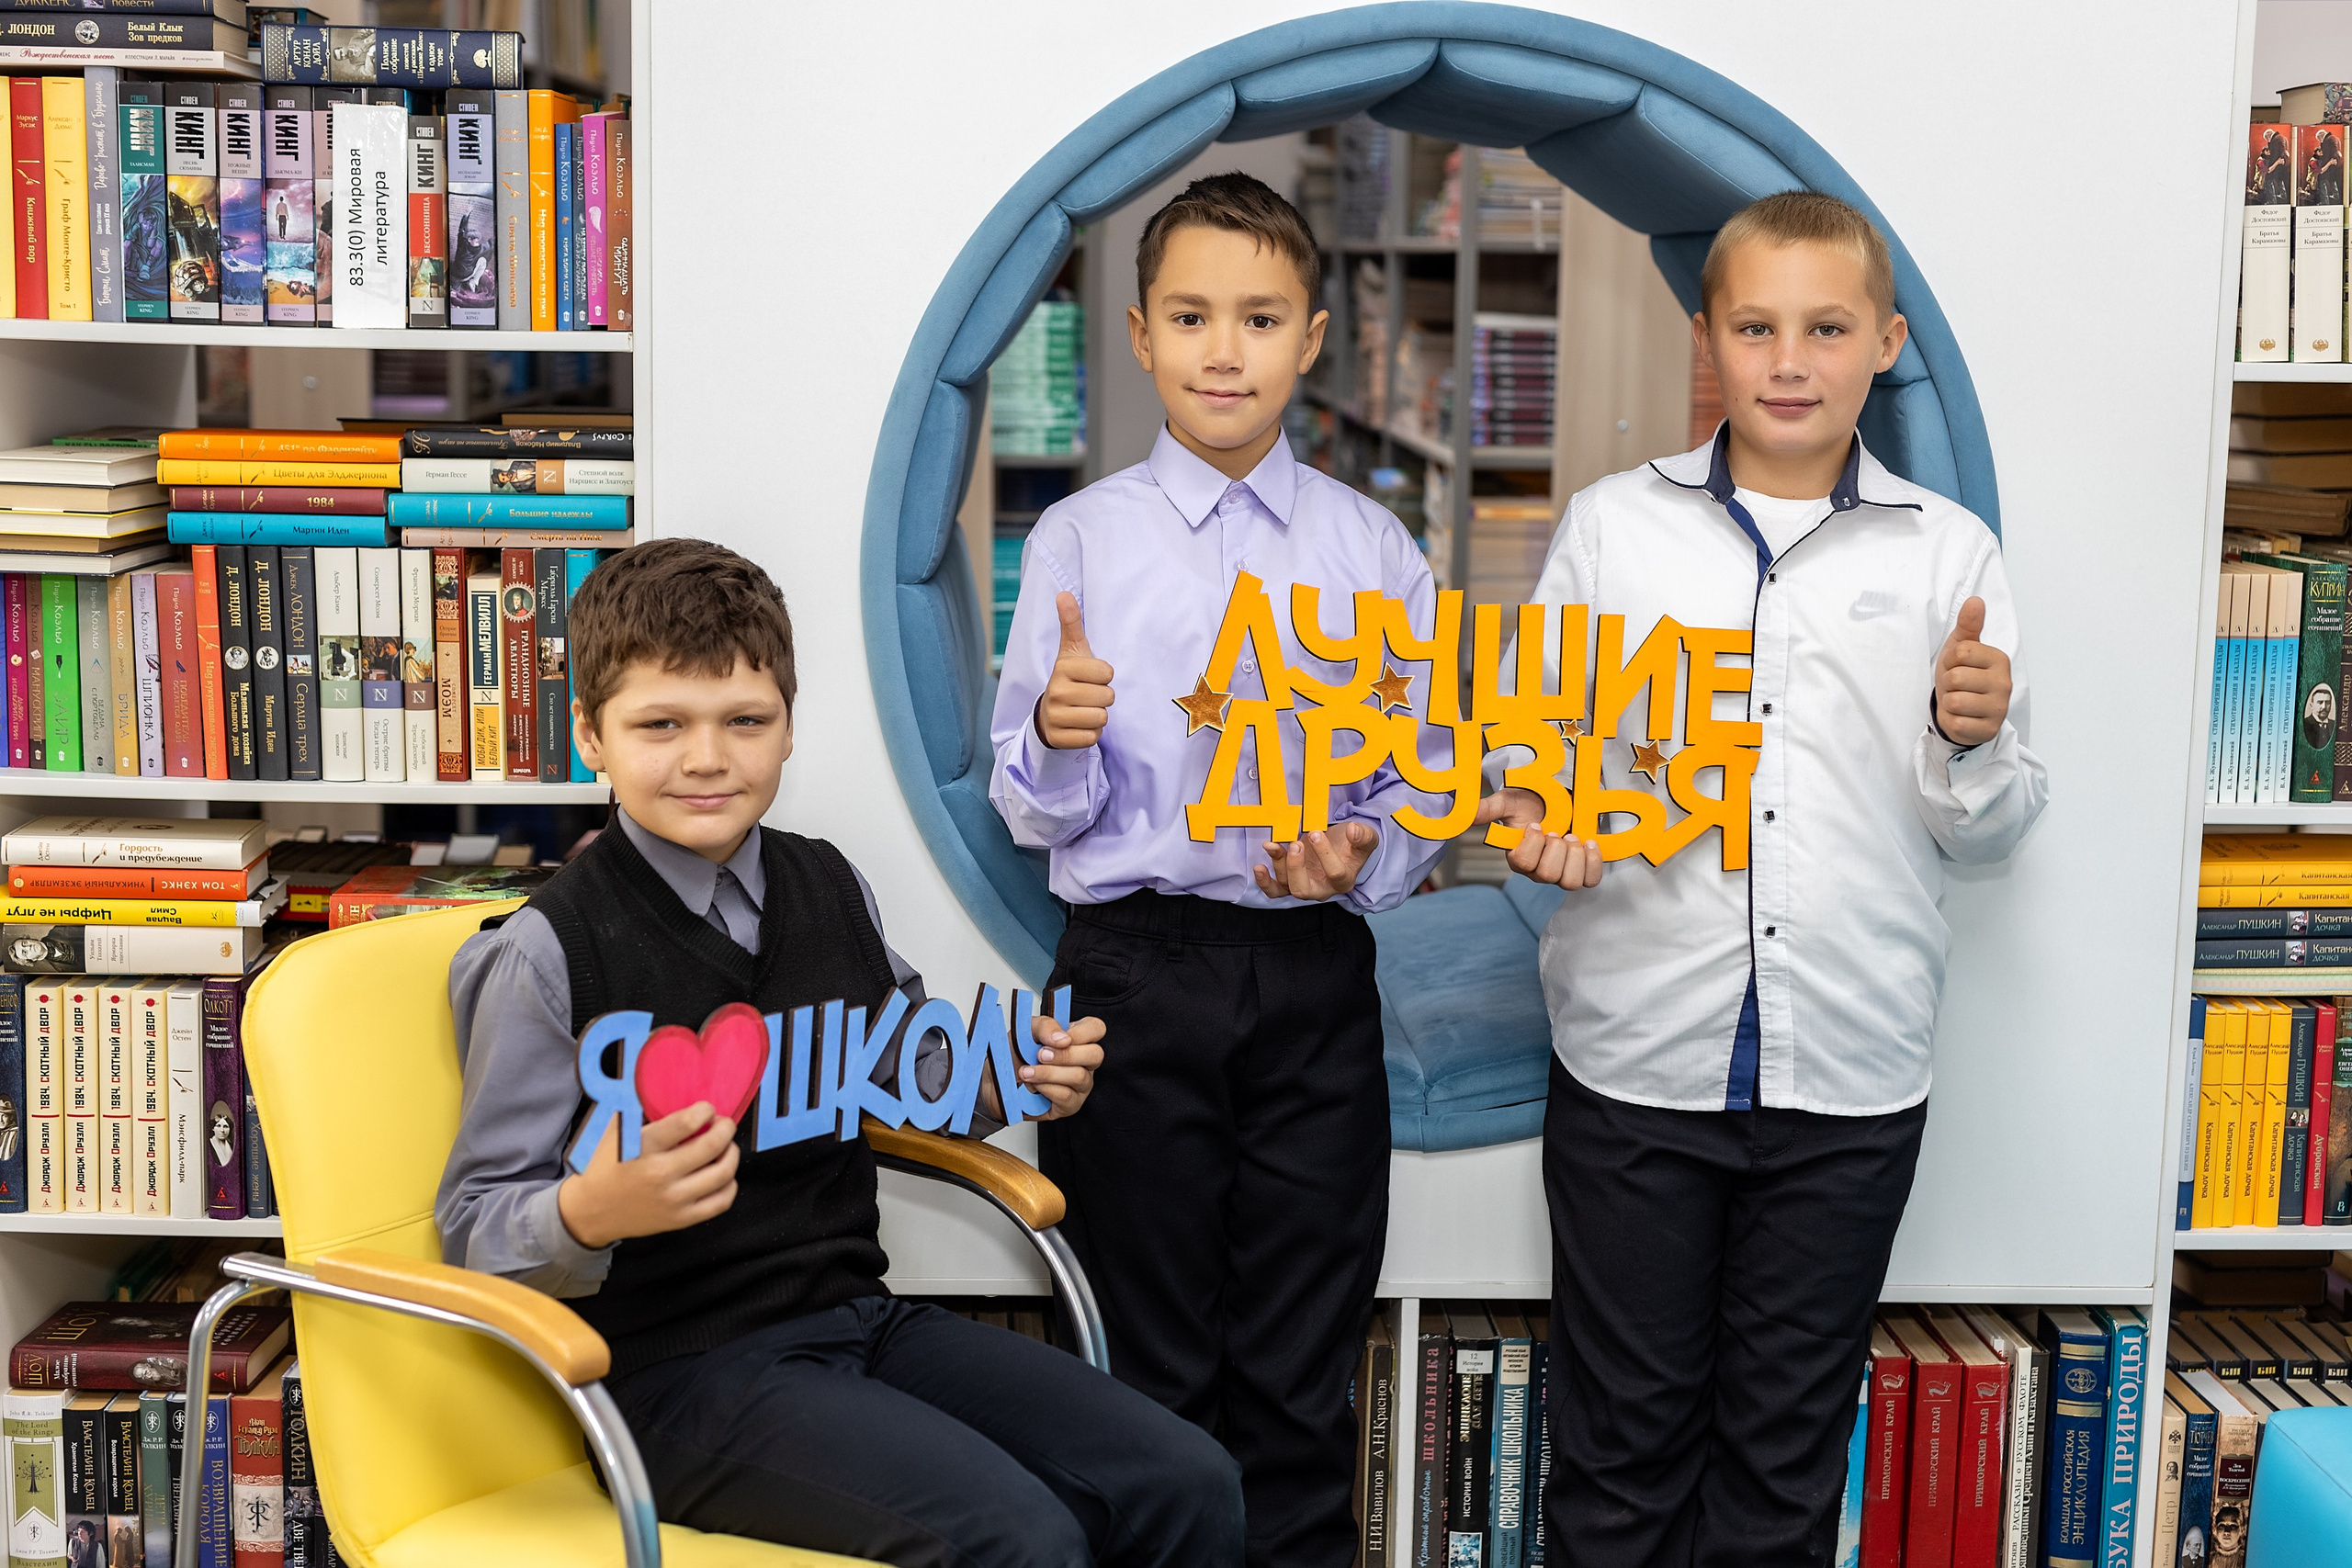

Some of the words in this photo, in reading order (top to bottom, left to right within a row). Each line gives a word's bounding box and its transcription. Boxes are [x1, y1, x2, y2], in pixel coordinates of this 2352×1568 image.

[8, 24, 55, 35] ЛОНДОН
[128, 22, 155, 32] Белый
[159, 22, 184, 32] Клык
[148, 34, 182, 43] предков
[19, 48, 90, 60] Рождественская
[313, 42, 322, 65] ДОЙЛ
[381, 41, 390, 71] Полное
[181, 96, 198, 105] СТИВЕН
[130, 108, 154, 156] КИНГ
[175, 112, 204, 159] КИНГ
[227, 113, 251, 160] КИНГ
[276, 115, 299, 161] КИНГ
[416, 127, 435, 137] СТИВЕН
[459, 118, 481, 164] КИНГ
[417, 144, 435, 187] КИНГ
[591, 154, 600, 195] Коэльо
[616, 158, 626, 197] Коэльо
[348, 148, 363, 223] Мировая
[27, 197, 36, 243] Книжный
[61, 198, 70, 222] Граф
[377, 170, 390, 265] литература
[424, 197, 432, 254] БЕССОННИЦА
[63, 226, 72, 291] Монте-Кристо
[349, 227, 363, 287] 83.3(0)
[274, 469, 304, 479] Цветы
[308, 470, 324, 479] для
[327, 469, 387, 479] Элджернона
[307, 497, 334, 507] 1984
[510, 509, 548, 517] Большие
[530, 533, 563, 542] Смерть
[226, 567, 238, 576] Д.
[255, 561, 268, 572] Д.
[228, 580, 242, 627] ЛОНДОН
[258, 580, 272, 632] ЛОНДОН
[2310, 582, 2346, 597] КУПРИН
[54, 605, 64, 644] Коэльо
[174, 611, 183, 649] Коэльо
[291, 592, 304, 648] ЛОНДОН
[479, 595, 492, 650] МЕЛВИЛЛ
[483, 652, 492, 684] ГЕРМАН
[510, 638, 518, 699] АВАНТЮРЫ
[522, 630, 530, 707] ГРАНДИОЗНЫЕ
[1203, 570, 1763, 748] ЛУЧШИЕ
[118, 694, 129, 738] БРИДА
[142, 679, 154, 741] ШПИОНКА
[230, 692, 239, 733] Большого
[240, 682, 249, 728] Маленькая
[265, 694, 274, 728] Мартин
[295, 682, 308, 730] Сердца
[442, 678, 451, 717] МОЭМ
[243, 731, 253, 765] хозяйка
[266, 730, 277, 752] Иден
[299, 733, 307, 762] трех
[477, 723, 485, 742] ДИК,
[489, 725, 498, 739] КИТ
[489, 740, 498, 765] БЕЛЫЙ
[1183, 697, 1760, 871] ДРУЗЬЯ
[119, 844, 163, 853] Гордость
[128, 854, 203, 863] предубеждение
[85, 880, 145, 888] УНИКАЛЬНЫЙ
[162, 880, 198, 889] ХЭНКС
[6, 908, 36, 918] лгут
[40, 910, 56, 919] не
[60, 910, 111, 920] Цифры
[2239, 919, 2281, 929] ПУШКИН
[2236, 950, 2279, 960] ПУШКИН
[40, 1008, 50, 1033] ДВОР
[74, 1008, 85, 1032] ДВОР
[111, 1009, 120, 1034] ДВОР
[146, 1011, 156, 1038] ДВОР
[204, 999, 233, 1013] ОЛКОТТ
[40, 1036, 50, 1083] СКОТНЫЙ
[75, 1036, 85, 1082] СКОТНЫЙ
[111, 1037, 120, 1083] СКОТНЫЙ
[147, 1040, 156, 1086] СКОТНЫЙ
[565, 1010, 653, 1175] Я
[752, 981, 1072, 1152] ШКОЛУ
[40, 1085, 50, 1110] 1984.
[75, 1084, 85, 1110] 1984.
[111, 1085, 120, 1110] 1984.
[2295, 1059, 2306, 1101] ПУШКИН
[147, 1089, 156, 1113] 1984.
[40, 1122, 50, 1154] ОРУЭЛЛ
[178, 1113, 187, 1183] Мэнсфилд-парк
[249, 1122, 261, 1169] Хорошие
[2203, 1122, 2213, 1172] Капитанская
[2225, 1122, 2235, 1172] Капитанская
[2247, 1122, 2257, 1171] Капитанская
[2270, 1122, 2279, 1172] Капитанская
[41, 1157, 51, 1193] ДЖОРДЖ
[76, 1157, 85, 1192] ДЖОРДЖ
[112, 1157, 121, 1193] ДЖОРДЖ
[147, 1161, 157, 1196] ДЖОРДЖ
[2313, 1134, 2324, 1190] Дубровский
[2201, 1175, 2210, 1199] дочка
[2245, 1173, 2253, 1197] дочка
[2268, 1174, 2277, 1199] дочка
[28, 1354, 44, 1384] ШОУ
[2019, 1374, 2028, 1410] ФЛОТЕ
[2113, 1335, 2143, 1484] ПРИРОДЫ
[1373, 1379, 1387, 1459] А.Н.Краснов
[1502, 1387, 1524, 1456] ШКОЛЬНИКА
[1886, 1400, 1894, 1427] КРАЙ
[1980, 1408, 1989, 1436] КРАЙ
[290, 1407, 305, 1480] ТОЛКИН
[2017, 1416, 2025, 1463] РУССКОМ
[1464, 1458, 1473, 1480] ВОЙН
[1882, 1430, 1893, 1500] ПРИМОРСКИЙ
[1929, 1438, 1939, 1506] ПРИМОРСКИЙ
[1975, 1438, 1987, 1507] ПРИМОРСКИЙ
[2064, 1429, 2075, 1495] РОССИЙСКАЯ
[1464, 1481, 1473, 1517] ИСТОРИЯ
[1498, 1458, 1522, 1529] СПРАВОЧНИК
[2012, 1479, 2021, 1530] РАССКАЗЫ
[2072, 1430, 2089, 1545] ЭНЦИКЛОПЕДИЯ
[211, 1460, 226, 1567] ВОЗВРАЩЕНИЕ
[1370, 1470, 1385, 1551] Н.И.Вавилов
[2060, 1496, 2071, 1544] БОЛЬШАЯ
[2162, 1501, 2177, 1535] Петр
